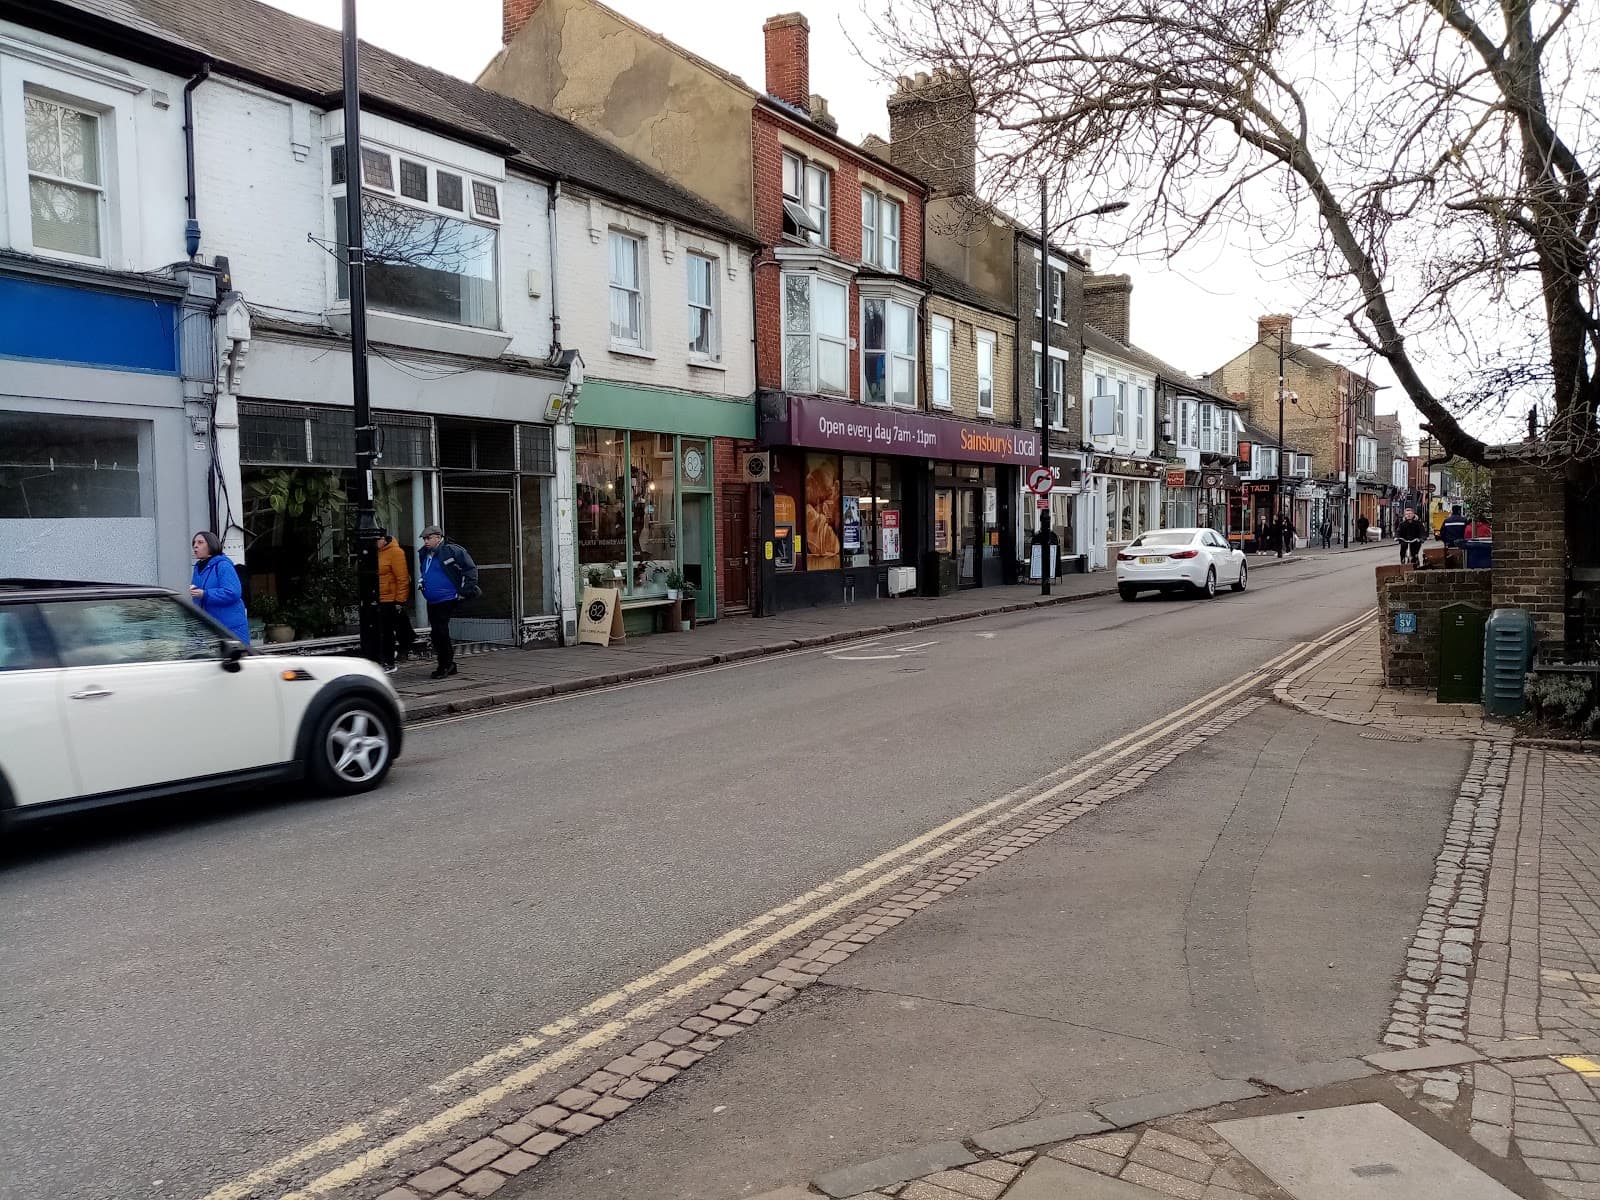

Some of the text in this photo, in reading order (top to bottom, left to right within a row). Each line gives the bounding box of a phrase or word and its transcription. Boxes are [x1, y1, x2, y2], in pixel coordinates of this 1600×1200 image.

[819, 416, 845, 438] Open
[847, 423, 873, 442] every
[874, 423, 892, 444] day
[893, 426, 911, 442] 7am
[916, 429, 937, 448] 11pm
[960, 428, 1036, 458] Sainsbury's Local
[687, 456, 699, 471] 82
[750, 461, 761, 471] 82
[590, 604, 604, 617] 82
[1399, 619, 1411, 627] SV
